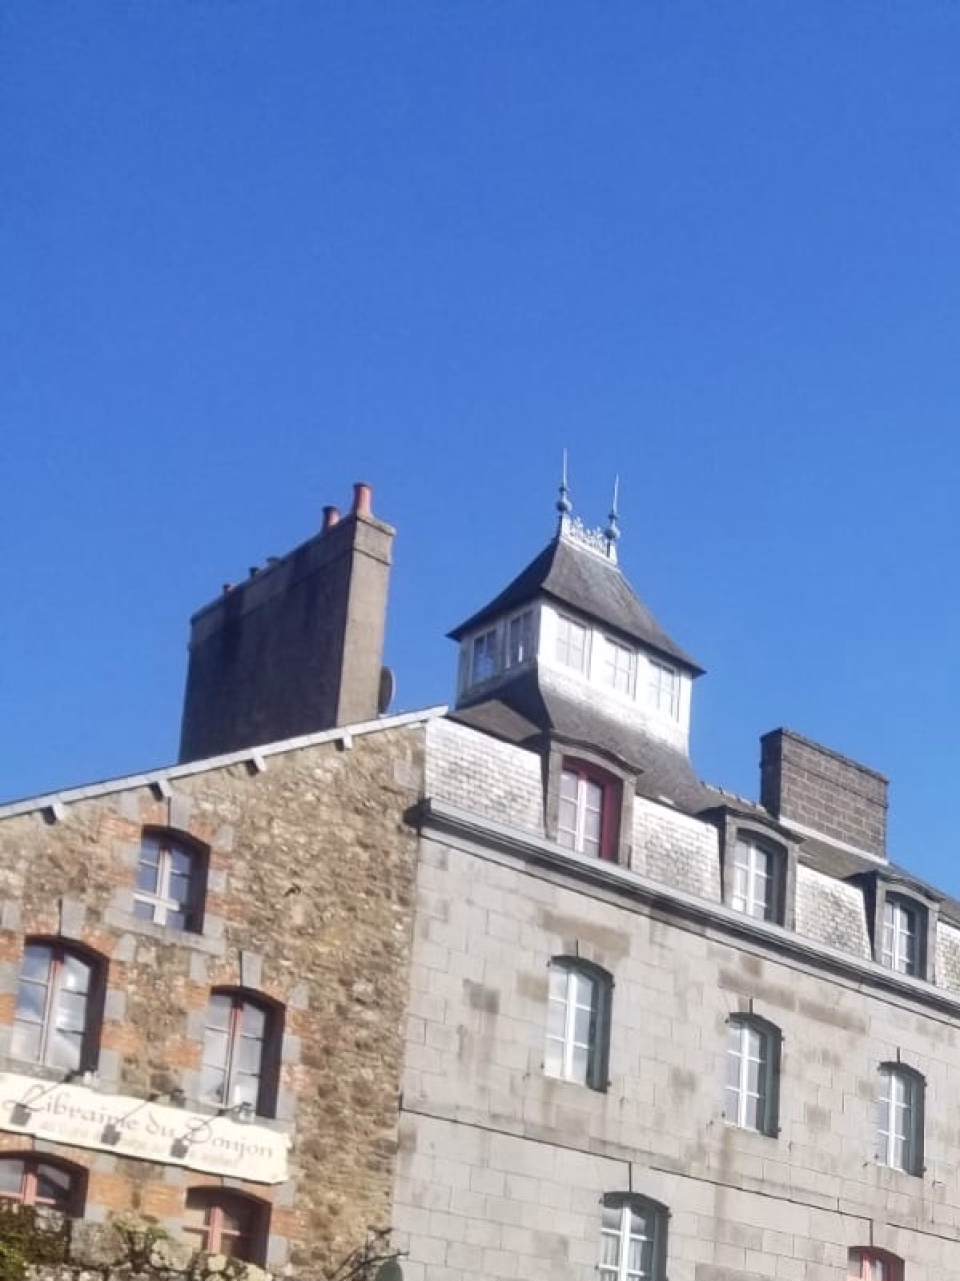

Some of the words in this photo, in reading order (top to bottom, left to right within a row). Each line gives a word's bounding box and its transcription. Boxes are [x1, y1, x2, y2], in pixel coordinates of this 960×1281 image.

[2, 1084, 139, 1130] Librairie
[146, 1111, 176, 1138] du
[183, 1116, 274, 1162] Donjon
